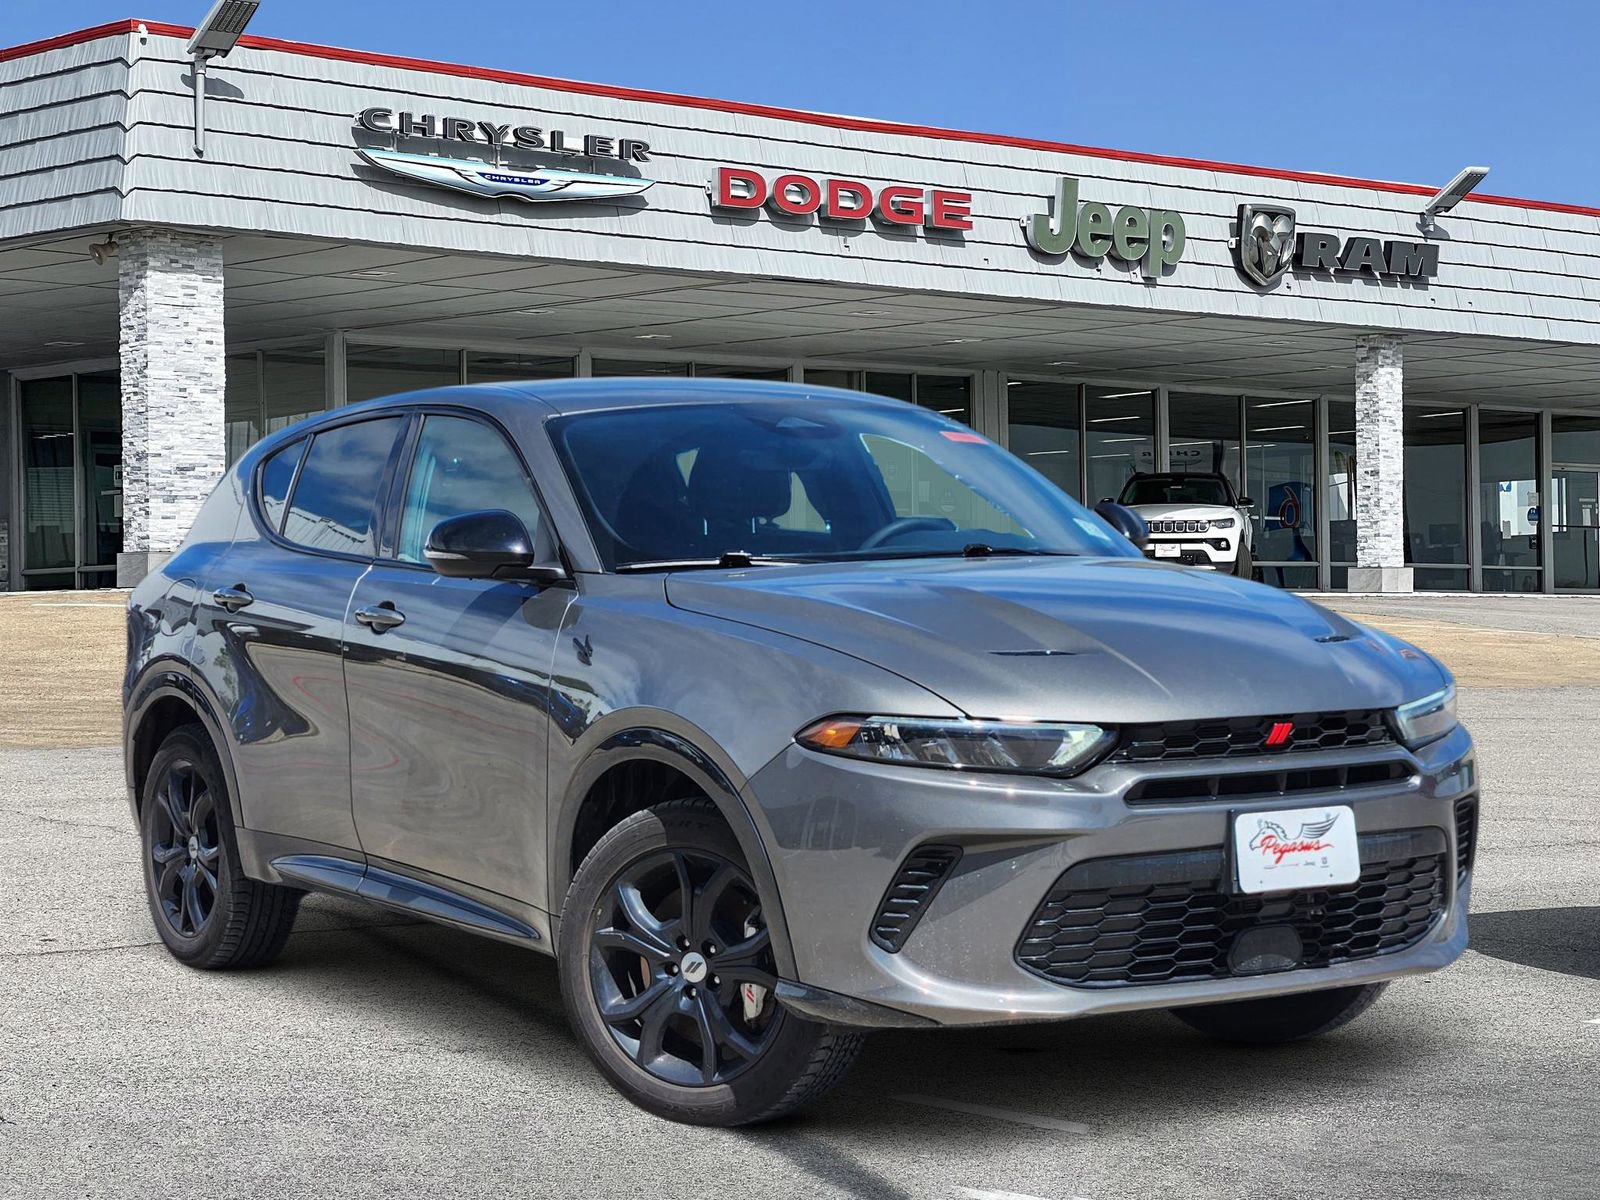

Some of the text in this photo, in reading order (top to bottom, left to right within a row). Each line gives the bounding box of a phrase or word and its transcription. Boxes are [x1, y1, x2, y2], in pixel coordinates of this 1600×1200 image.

[356, 106, 652, 162] CHRYSLER
[484, 173, 542, 186] CHRYSLER
[712, 166, 974, 230] DODGE
[1028, 177, 1187, 278] Jeep
[1299, 232, 1440, 277] RAM
[1261, 834, 1335, 864] Pegasus
